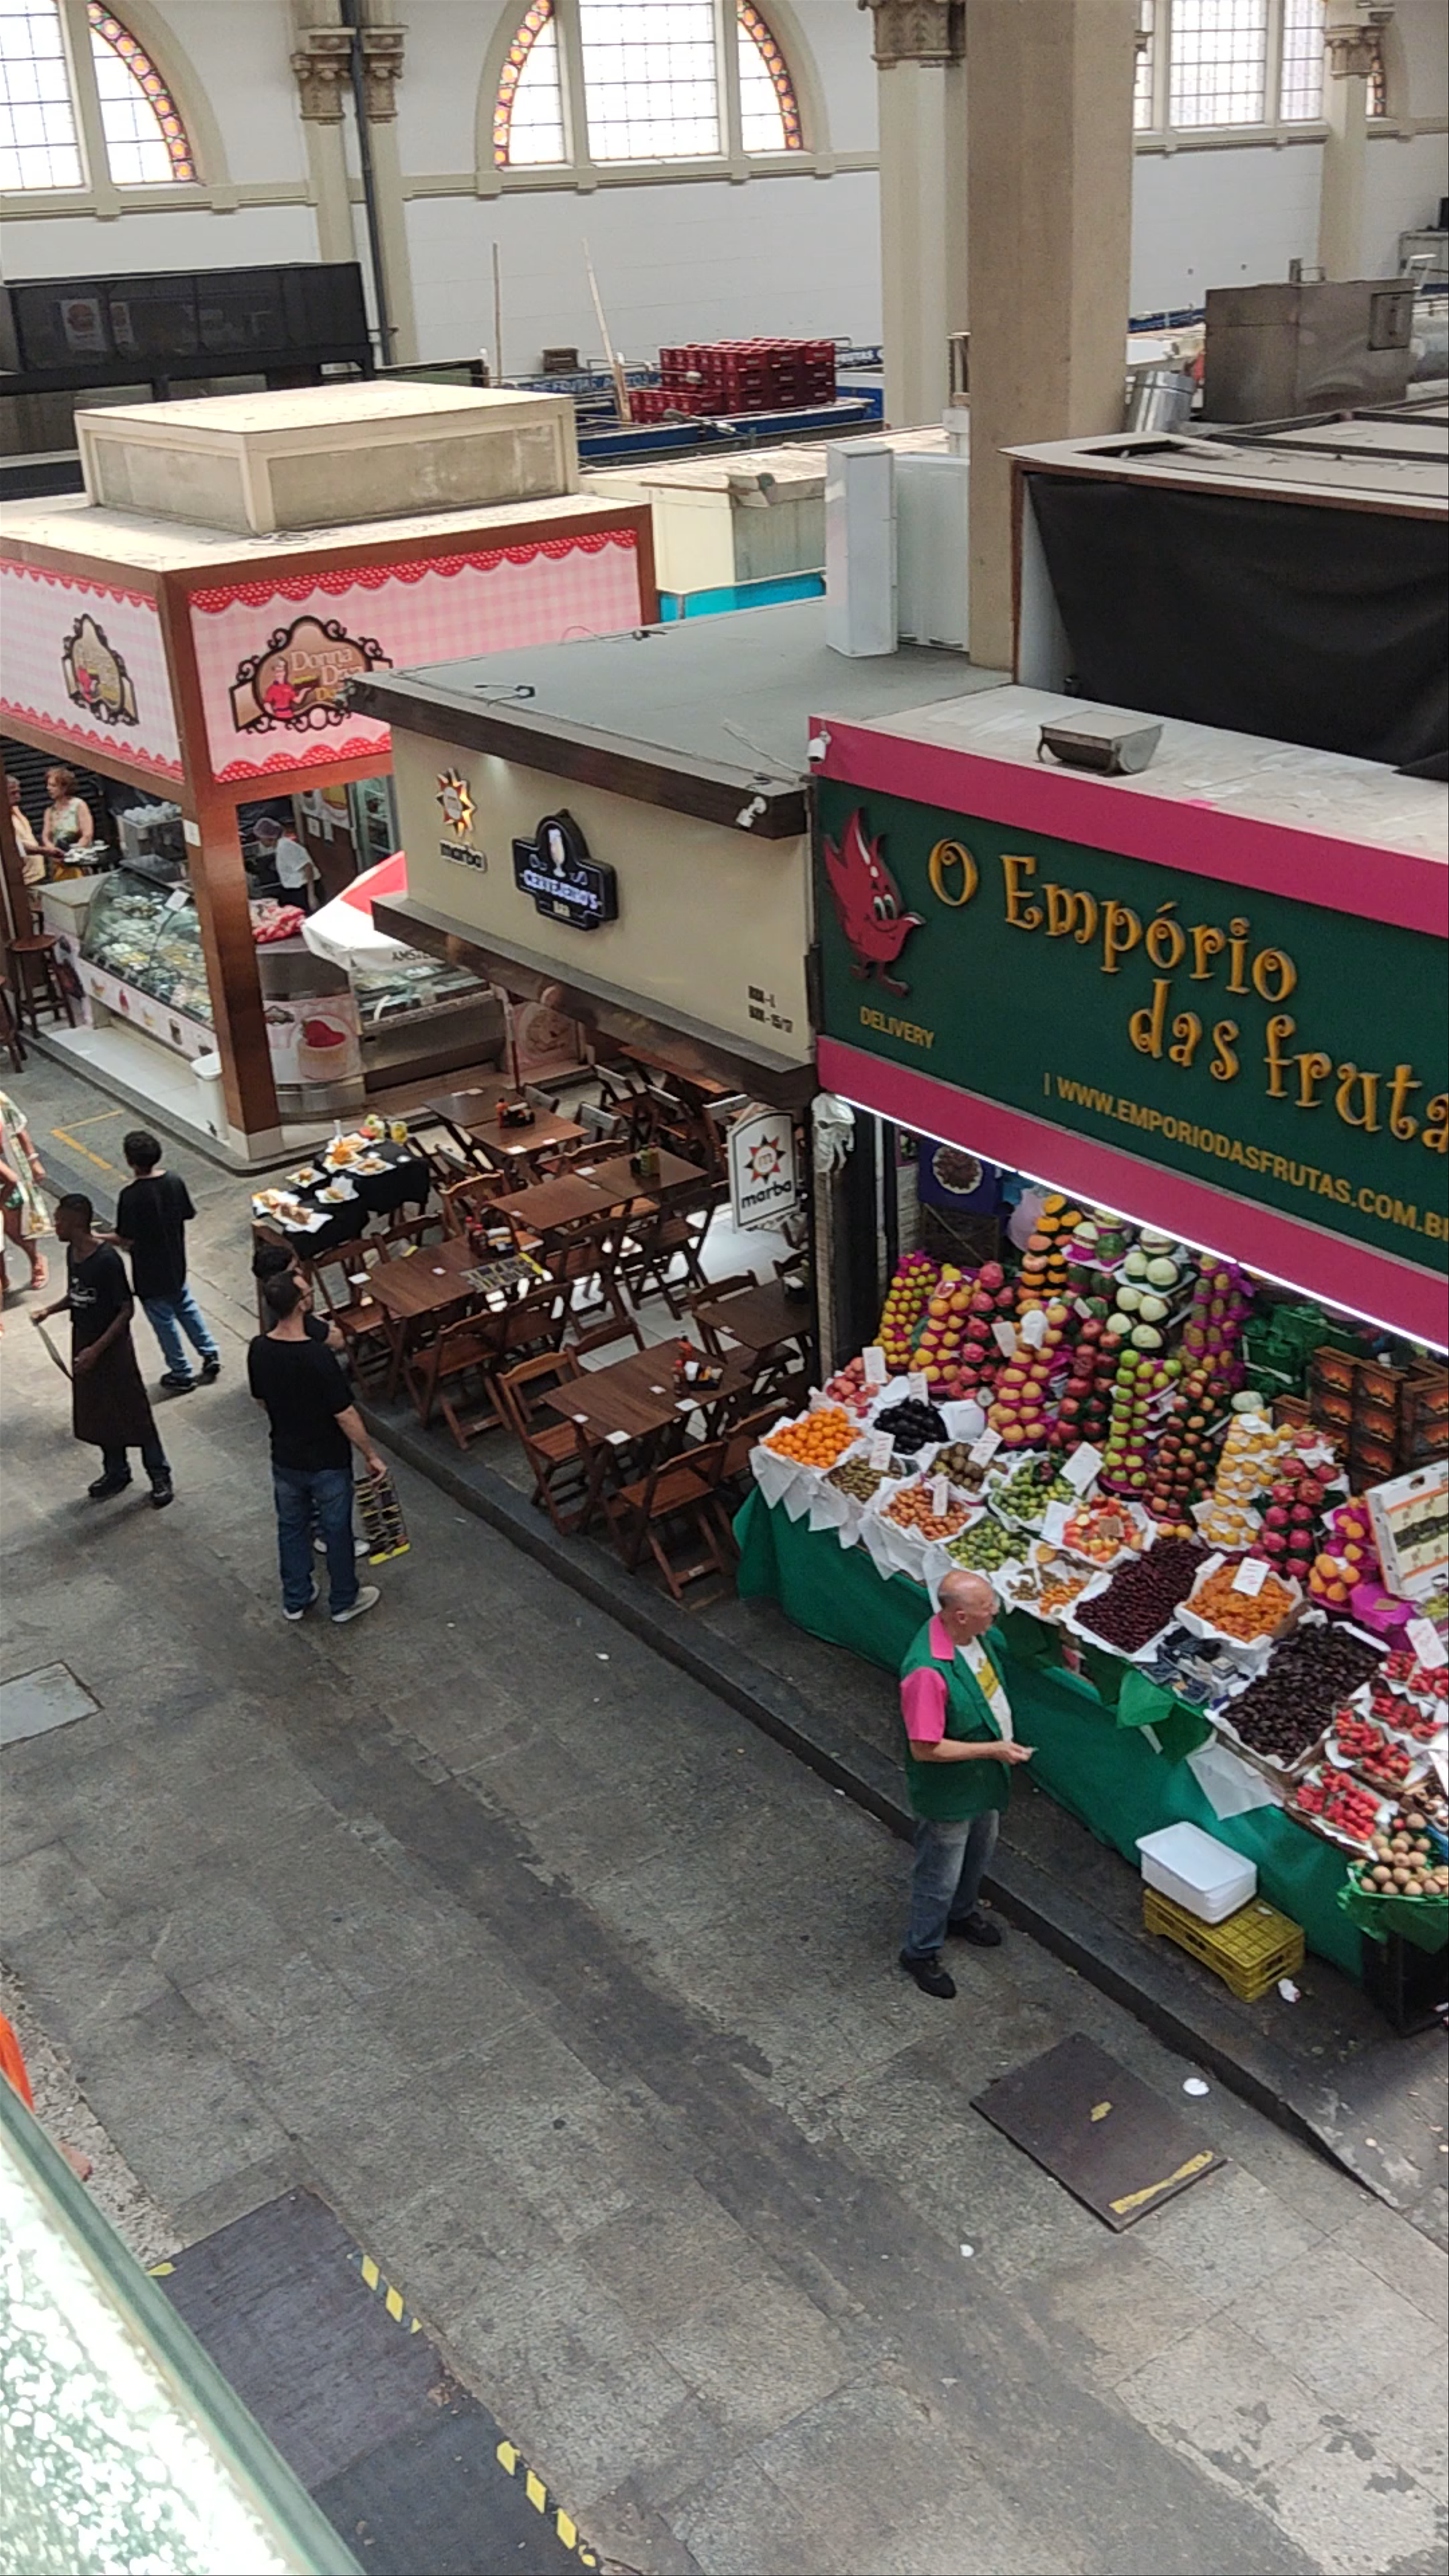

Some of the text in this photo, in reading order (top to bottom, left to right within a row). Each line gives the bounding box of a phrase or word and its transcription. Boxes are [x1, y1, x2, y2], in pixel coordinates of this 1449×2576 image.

[291, 648, 352, 671] Donna
[928, 838, 1297, 1002] O Empório
[860, 1006, 934, 1049] DELIVERY
[1129, 978, 1240, 1081] das
